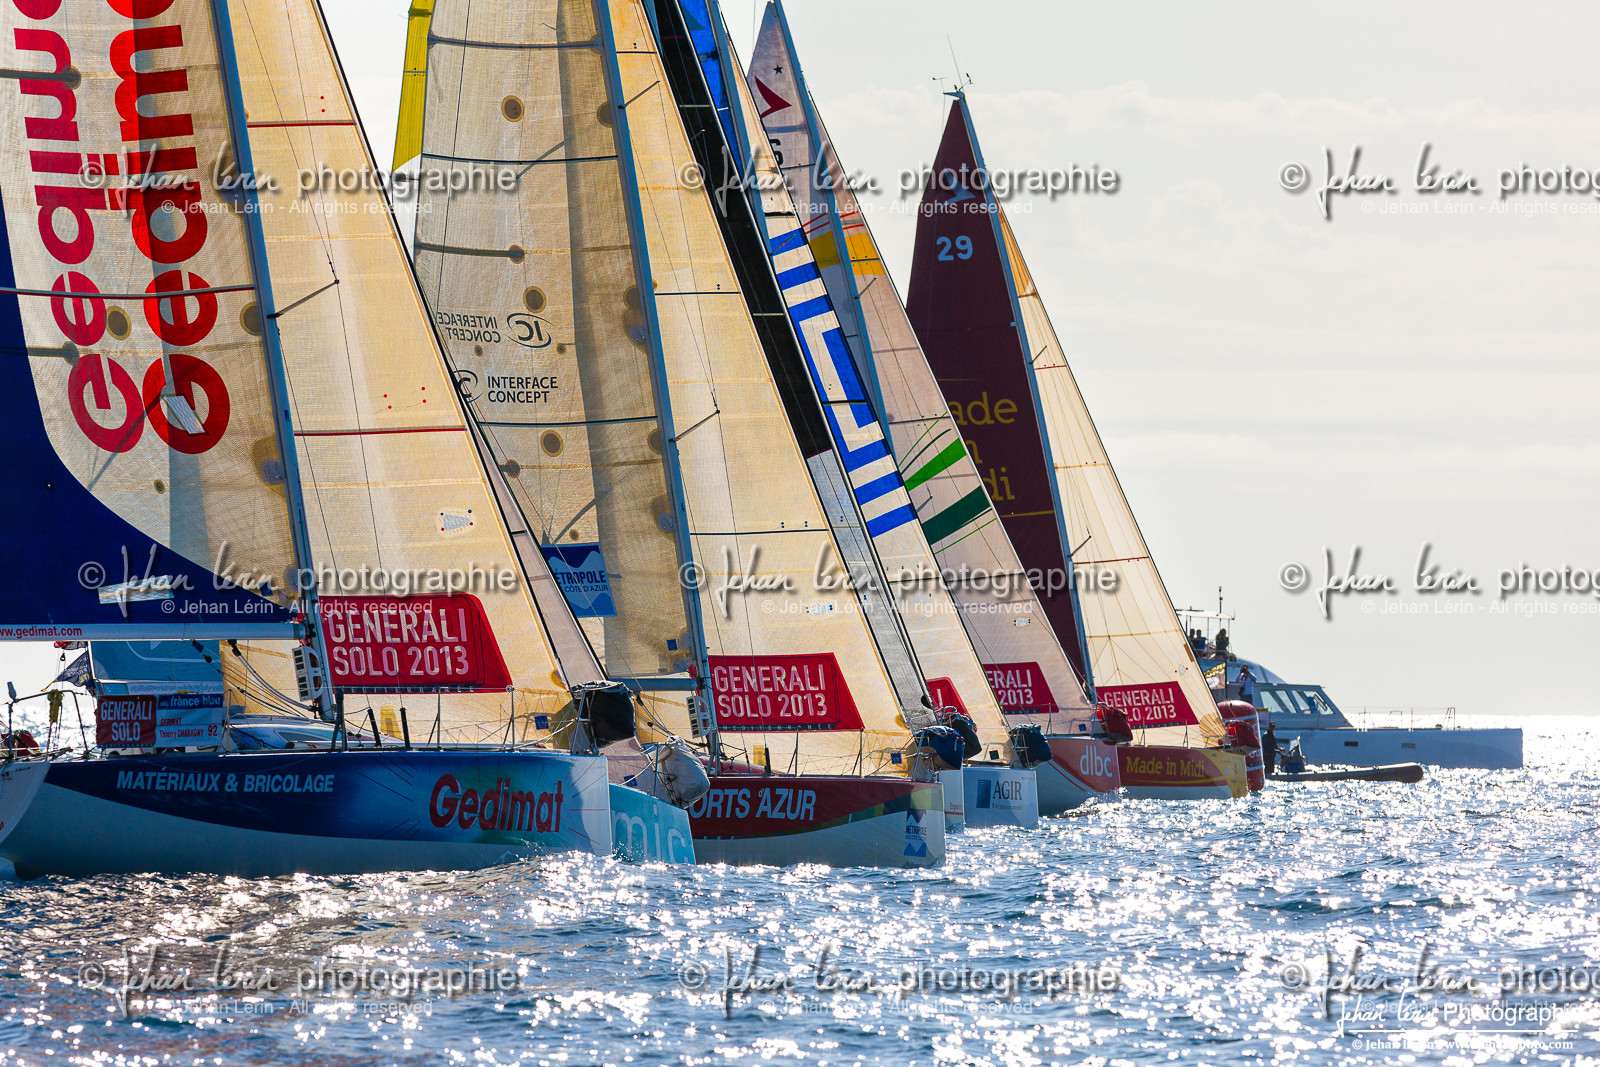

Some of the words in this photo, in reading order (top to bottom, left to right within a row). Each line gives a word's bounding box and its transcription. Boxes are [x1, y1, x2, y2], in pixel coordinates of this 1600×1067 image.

[107, 0, 231, 455] Gedim
[936, 235, 973, 261] 29
[487, 376, 558, 389] INTERFACE
[487, 390, 550, 403] CONCEPT
[328, 608, 468, 643] GENERALI
[332, 646, 398, 676] SOLO
[407, 645, 469, 676] 2013
[713, 663, 826, 693] GENERALI
[170, 695, 200, 707] france
[717, 693, 772, 718] SOLO
[777, 692, 828, 717] 2013
[998, 689, 1034, 705] 2013
[1103, 687, 1175, 708] GENERALI
[101, 700, 152, 720] GENERALI
[1144, 704, 1177, 720] 2013
[111, 721, 140, 741] SOLO
[207, 724, 218, 737] 92
[1080, 745, 1112, 777] dlbc
[1126, 756, 1163, 775] Made
[1166, 756, 1177, 776] in
[1180, 759, 1205, 778] Midi
[116, 766, 220, 791] MATÉRIAUX
[224, 773, 239, 792] &
[243, 774, 335, 793] BRICOLAGE
[992, 780, 1023, 800] AGIR
[429, 773, 564, 833] Gedimat
